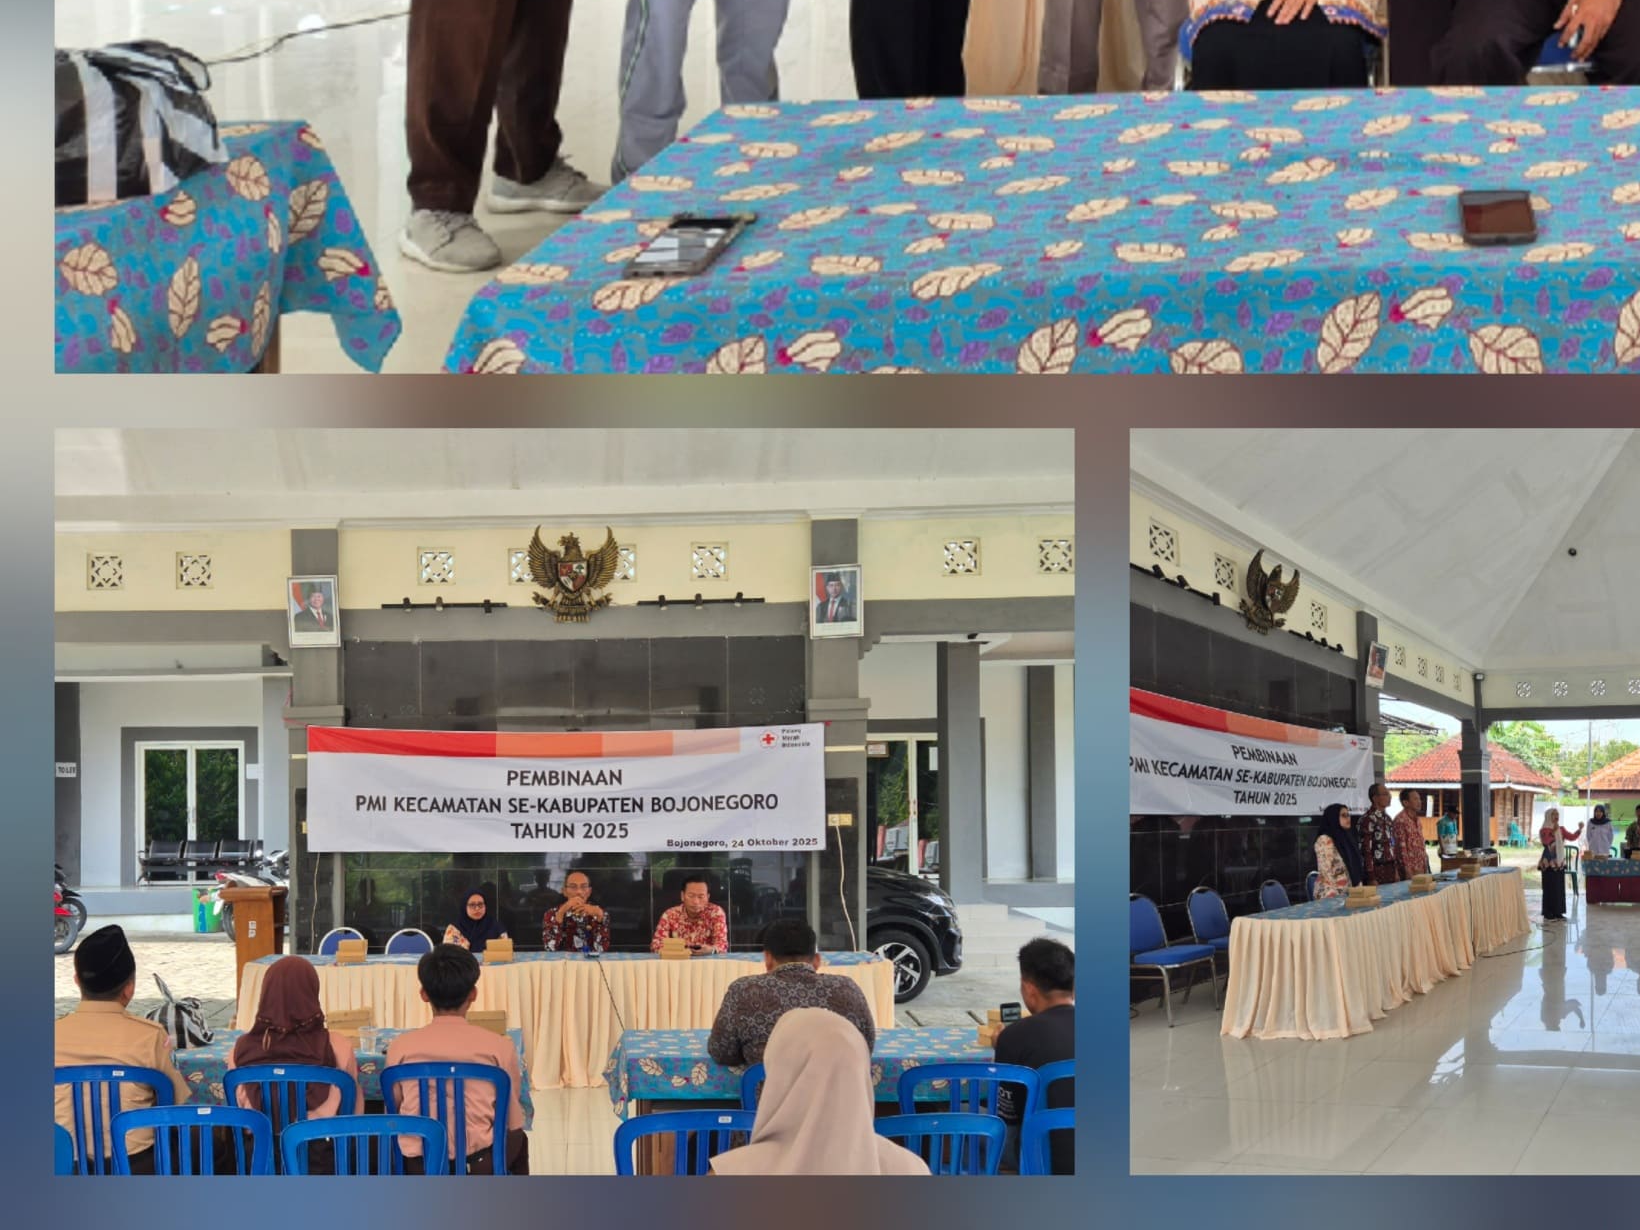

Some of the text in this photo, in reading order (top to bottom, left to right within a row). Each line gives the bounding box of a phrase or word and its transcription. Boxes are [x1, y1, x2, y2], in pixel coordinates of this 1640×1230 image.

[1231, 744, 1298, 766] PEMBINAAN
[506, 769, 623, 787] PEMBINAAN
[1150, 759, 1233, 783] KECAMATAN
[1235, 768, 1307, 787] SE-KABUPATEN
[355, 794, 778, 814] PMI KECAMATAN SE-KABUPATEN BOJONEGORO
[1233, 790, 1298, 806] TAHUN 2025
[510, 823, 629, 840] TAHUN 2025
[666, 837, 818, 849] Bojonegoro, 24 Oktober 2025
